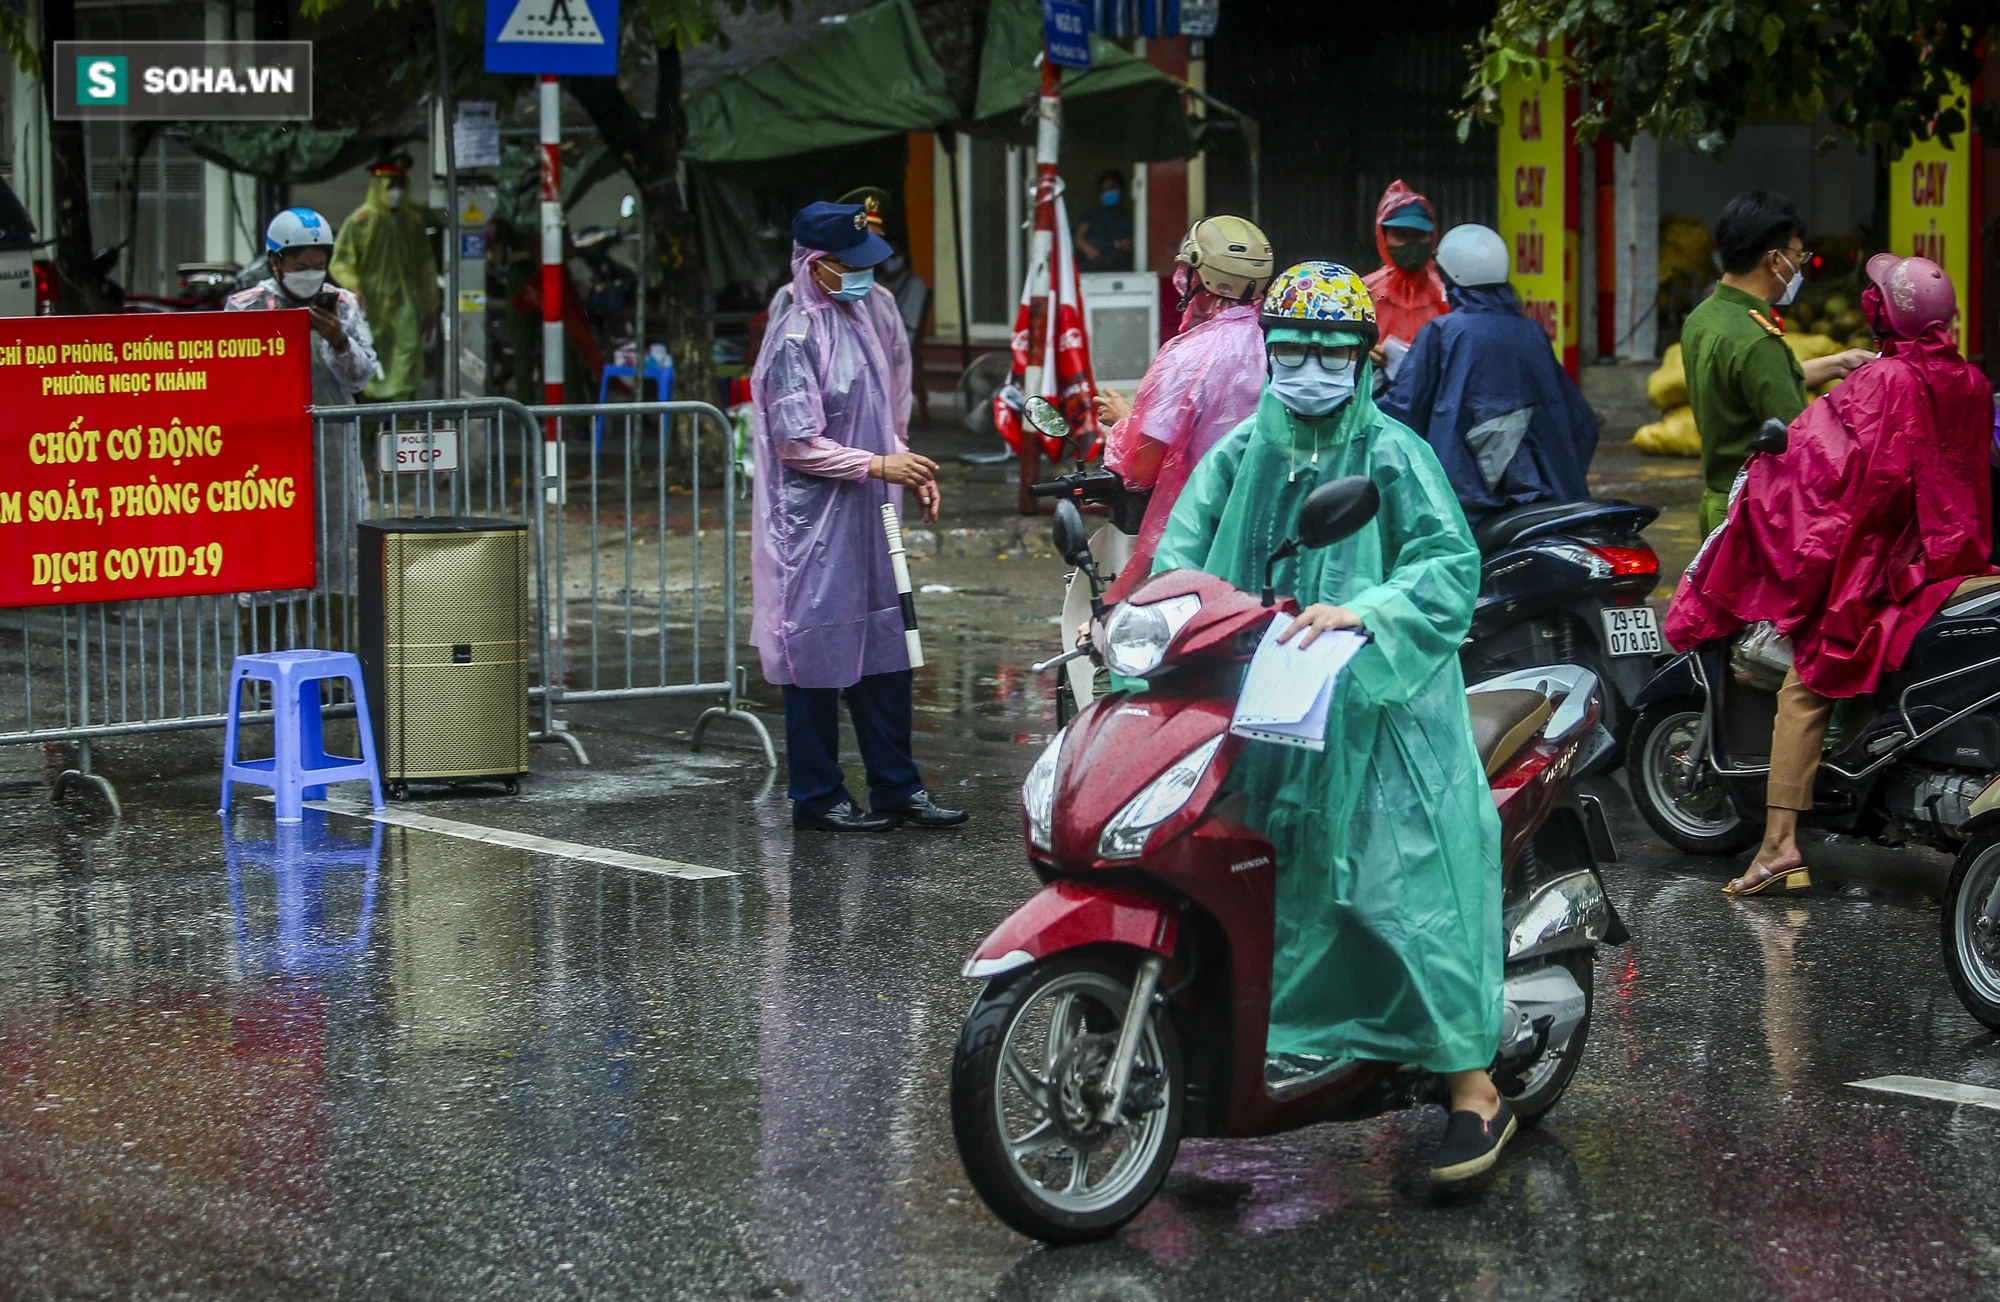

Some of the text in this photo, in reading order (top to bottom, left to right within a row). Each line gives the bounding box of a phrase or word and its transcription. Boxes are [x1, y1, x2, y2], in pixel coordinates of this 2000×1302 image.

[1515, 166, 1546, 209] CAY
[1911, 160, 1950, 207] CAY
[1516, 218, 1545, 275] HẢI
[0, 335, 286, 369] CHỈ ĐẠO PHÒNG, CHỐNG DỊCH COVID-19
[42, 368, 207, 396] PHƯỜNG NGỌC KHÁNH
[28, 415, 223, 466] CHỐT CƠ ĐỘNG
[396, 449, 442, 463] STOP
[28, 479, 104, 525] SOÁT,
[109, 475, 201, 518] PHÒNG
[206, 464, 296, 512] CHỐNG
[32, 542, 223, 592] DỊCH COVID-19
[1611, 610, 1651, 630] 29-E2
[1611, 632, 1658, 652] 078.05
[1231, 857, 1269, 872] HONDA
